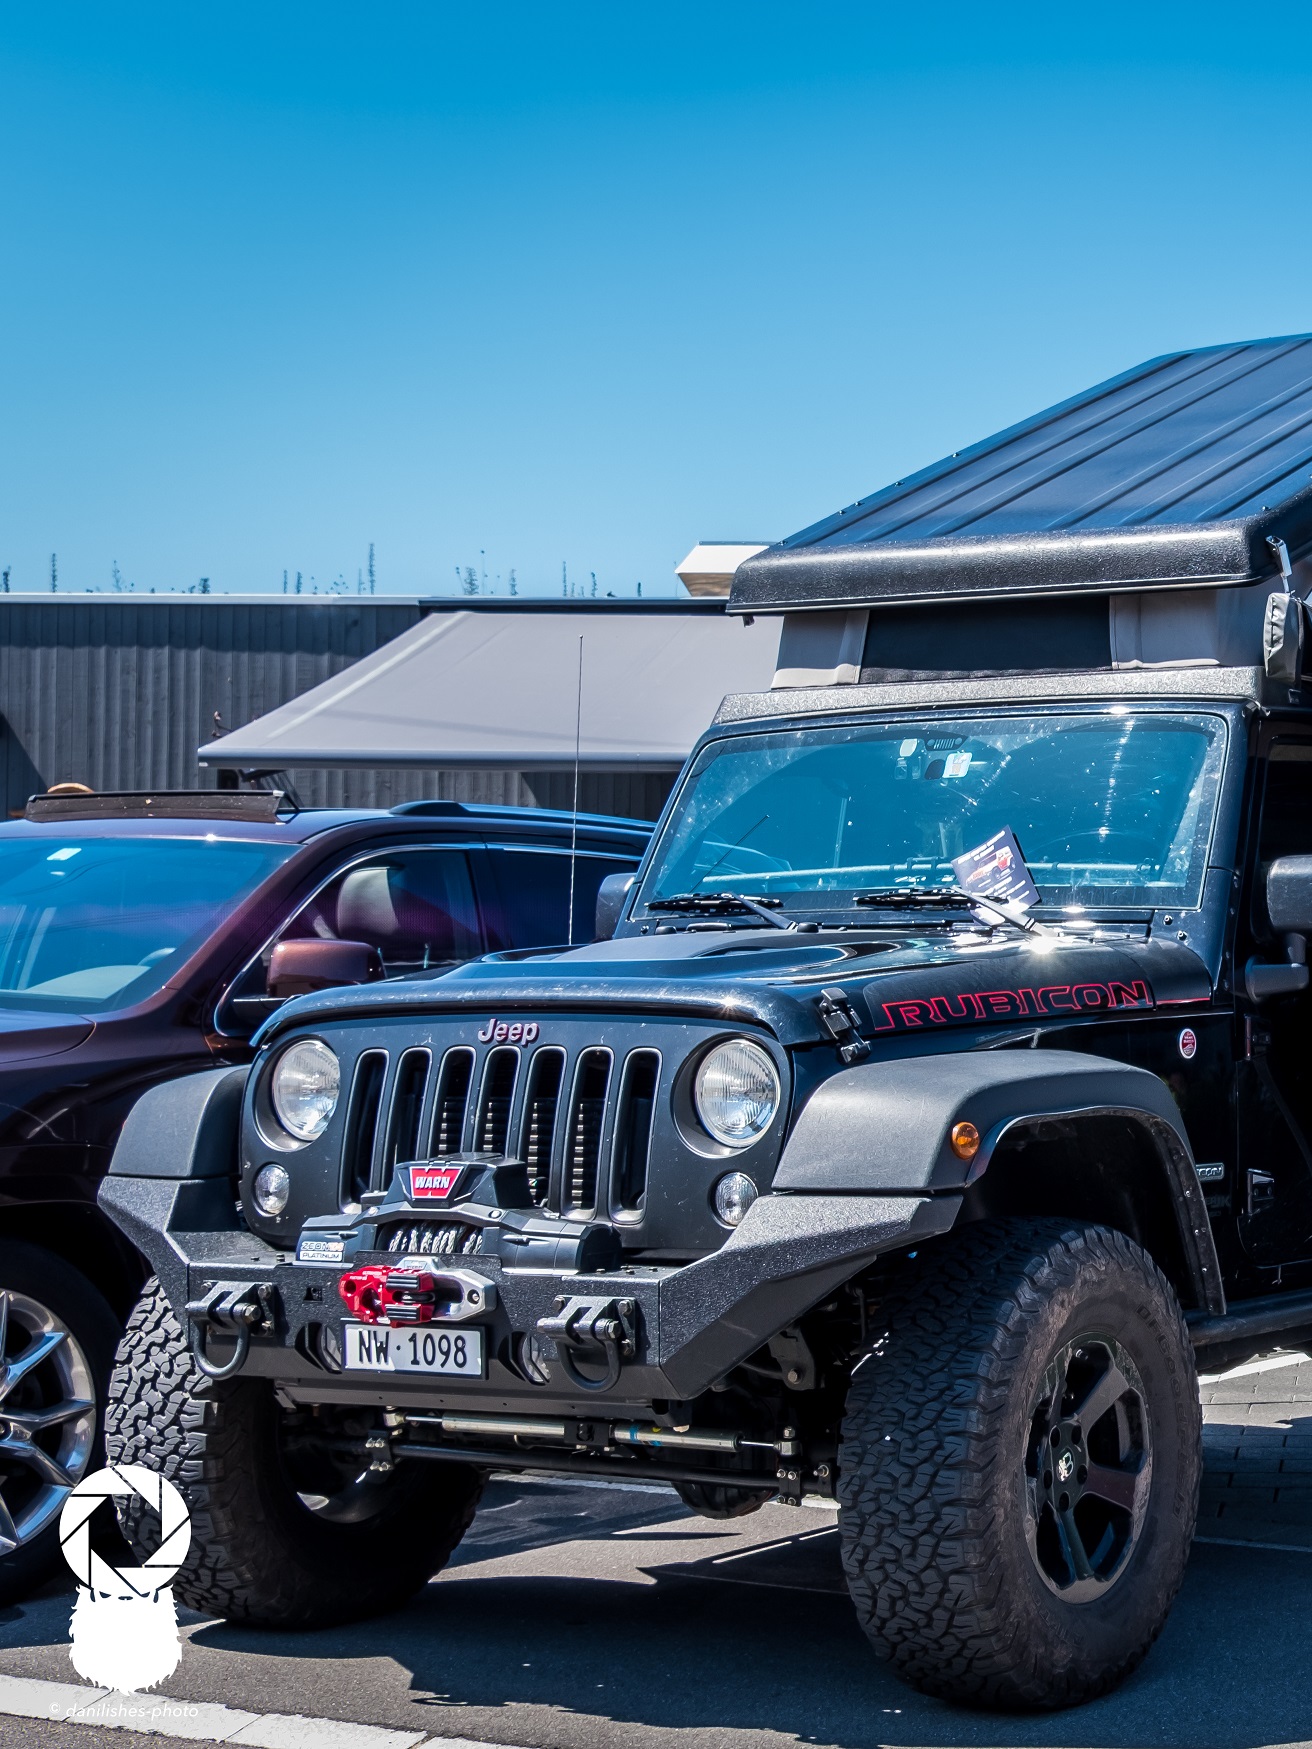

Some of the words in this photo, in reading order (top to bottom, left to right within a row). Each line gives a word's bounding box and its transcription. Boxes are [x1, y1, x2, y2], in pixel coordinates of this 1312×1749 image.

[875, 980, 1154, 1031] RUBICON
[478, 1018, 539, 1047] Jeep
[414, 1176, 451, 1189] WARN
